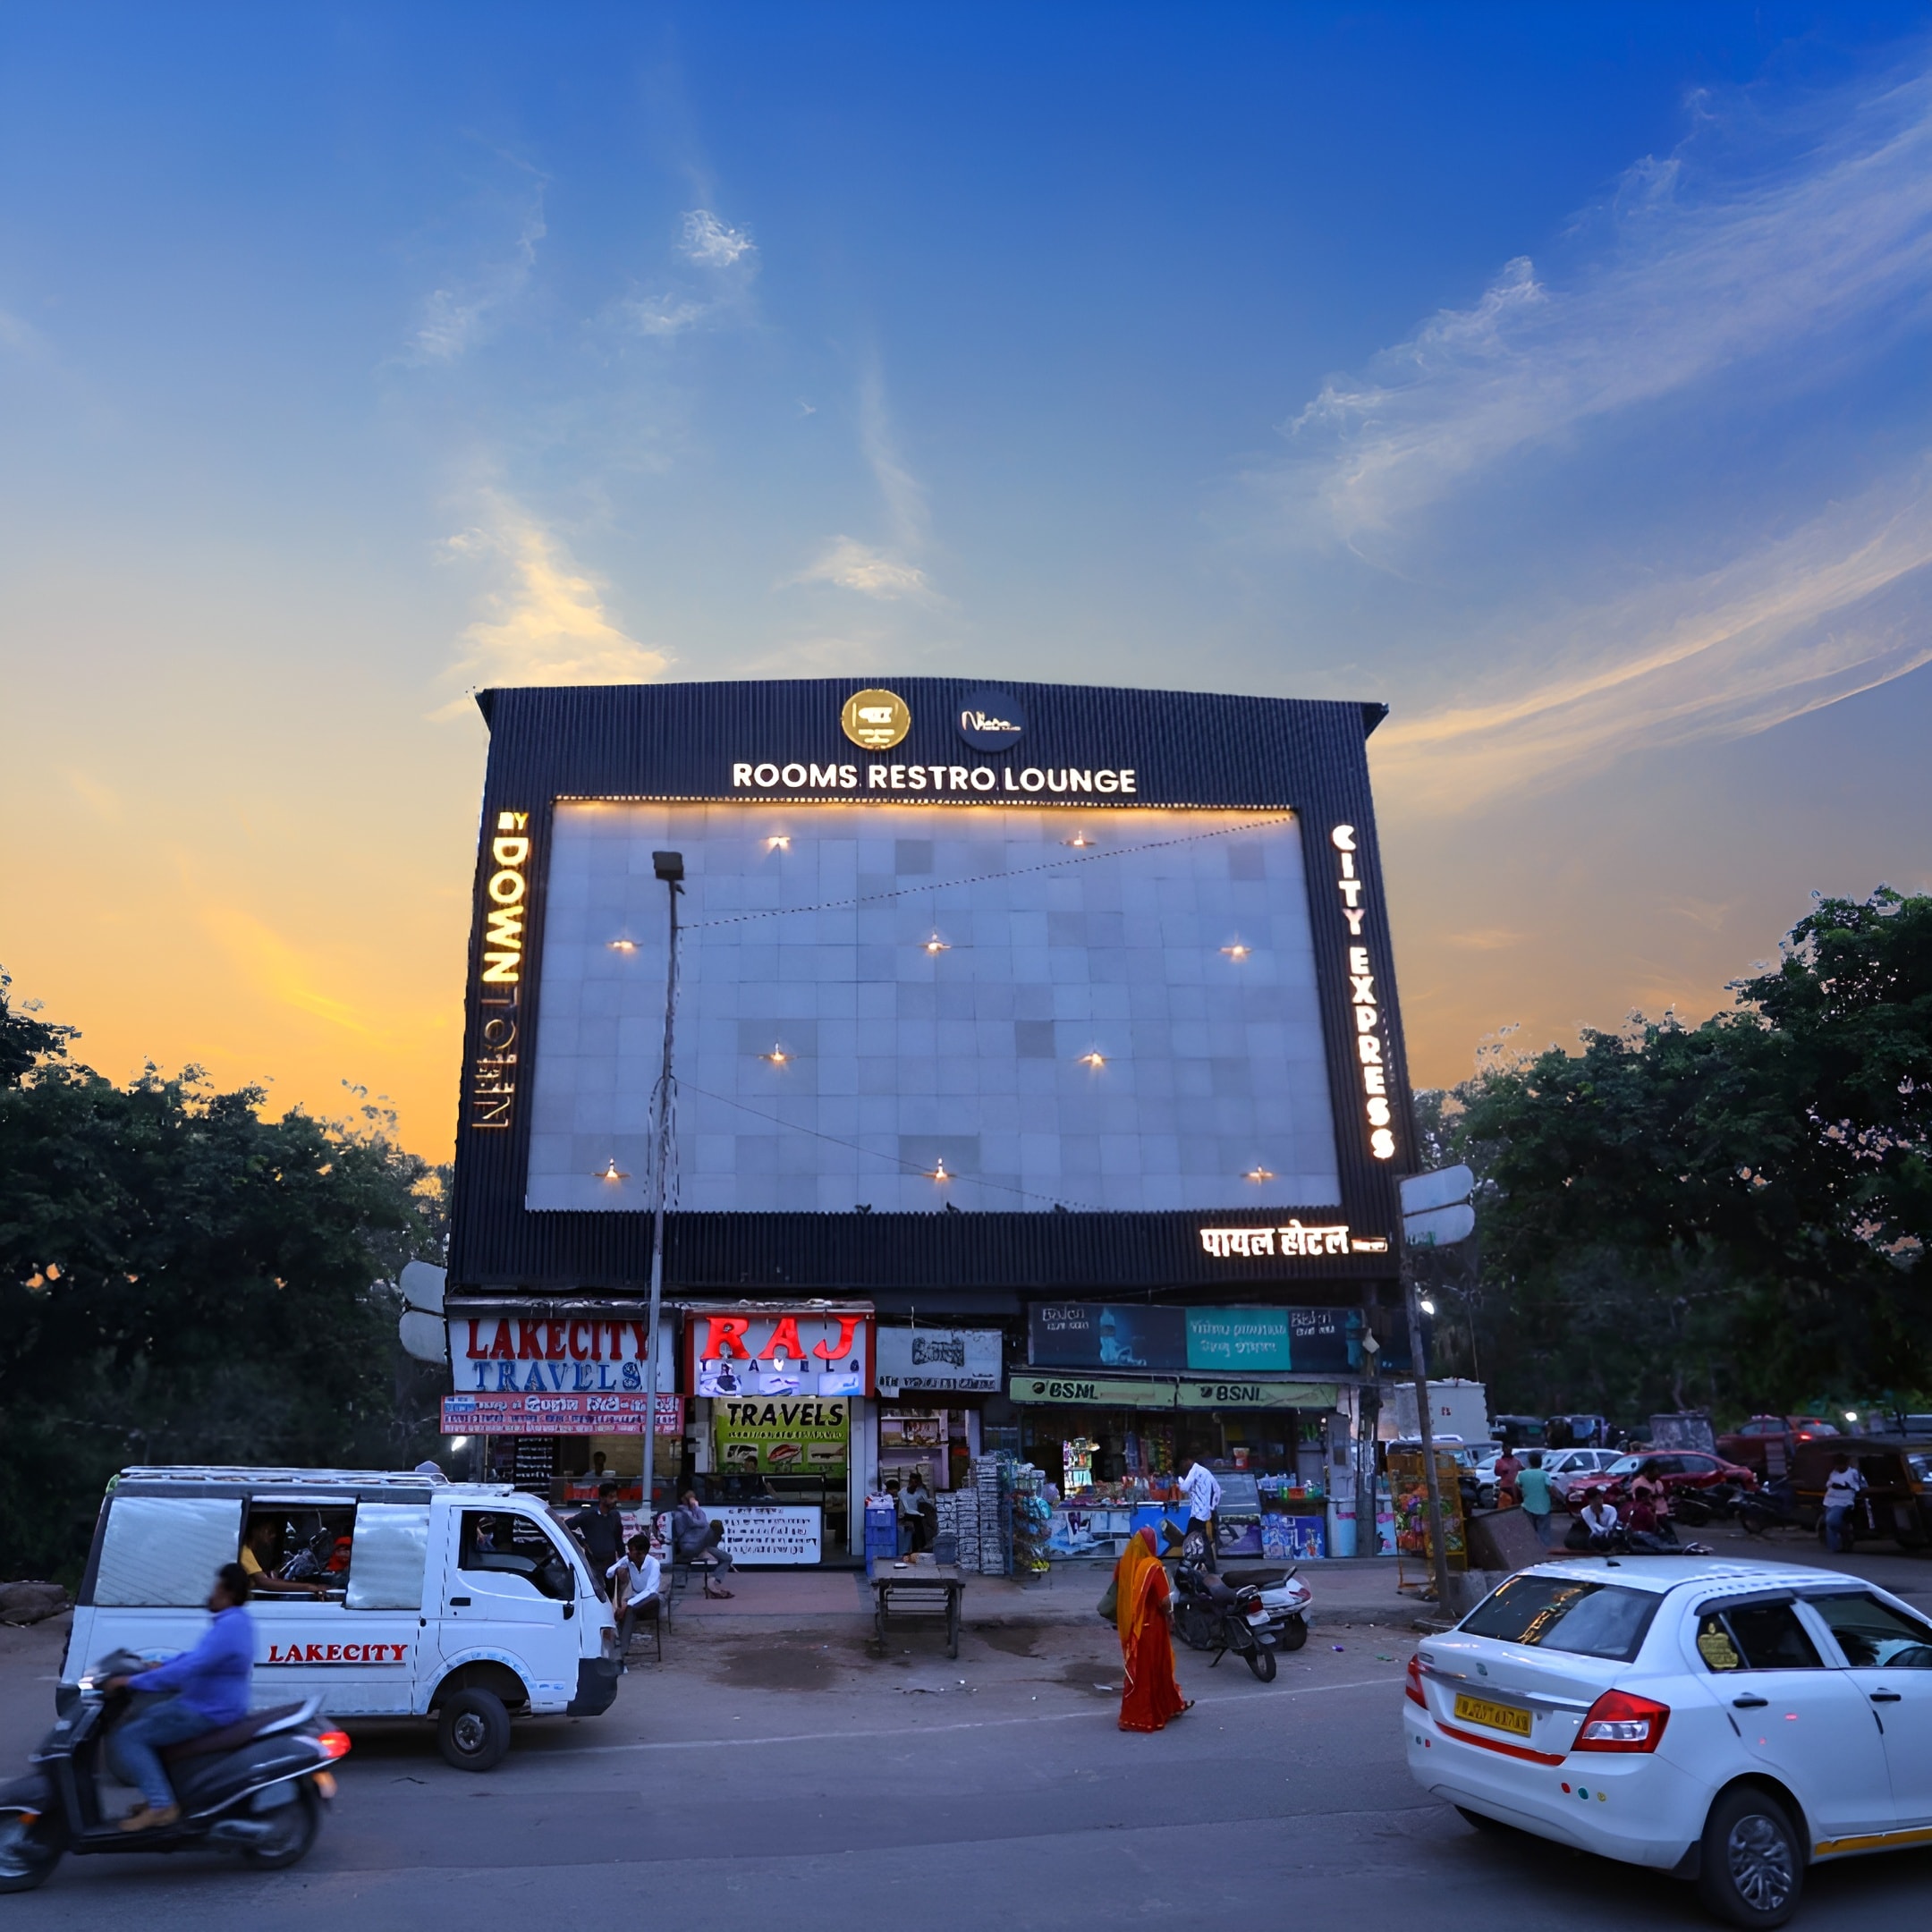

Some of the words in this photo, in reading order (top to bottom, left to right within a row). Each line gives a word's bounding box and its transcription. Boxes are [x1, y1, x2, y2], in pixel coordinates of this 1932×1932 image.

[733, 763, 858, 788] ROOMS
[868, 767, 996, 791] RESTRO
[1004, 768, 1137, 793] LOUNGE
[1332, 824, 1366, 936] CITY
[1348, 946, 1395, 1159] EXPRESS
[1200, 1228, 1275, 1257] पायल
[1277, 1219, 1349, 1256] होटल
[466, 1319, 648, 1360] LAKECITY
[700, 1315, 863, 1360] RAJ
[472, 1361, 642, 1392] TRAVELS
[727, 1403, 843, 1427] TRAVELS
[268, 1644, 409, 1662] LAKECITY
